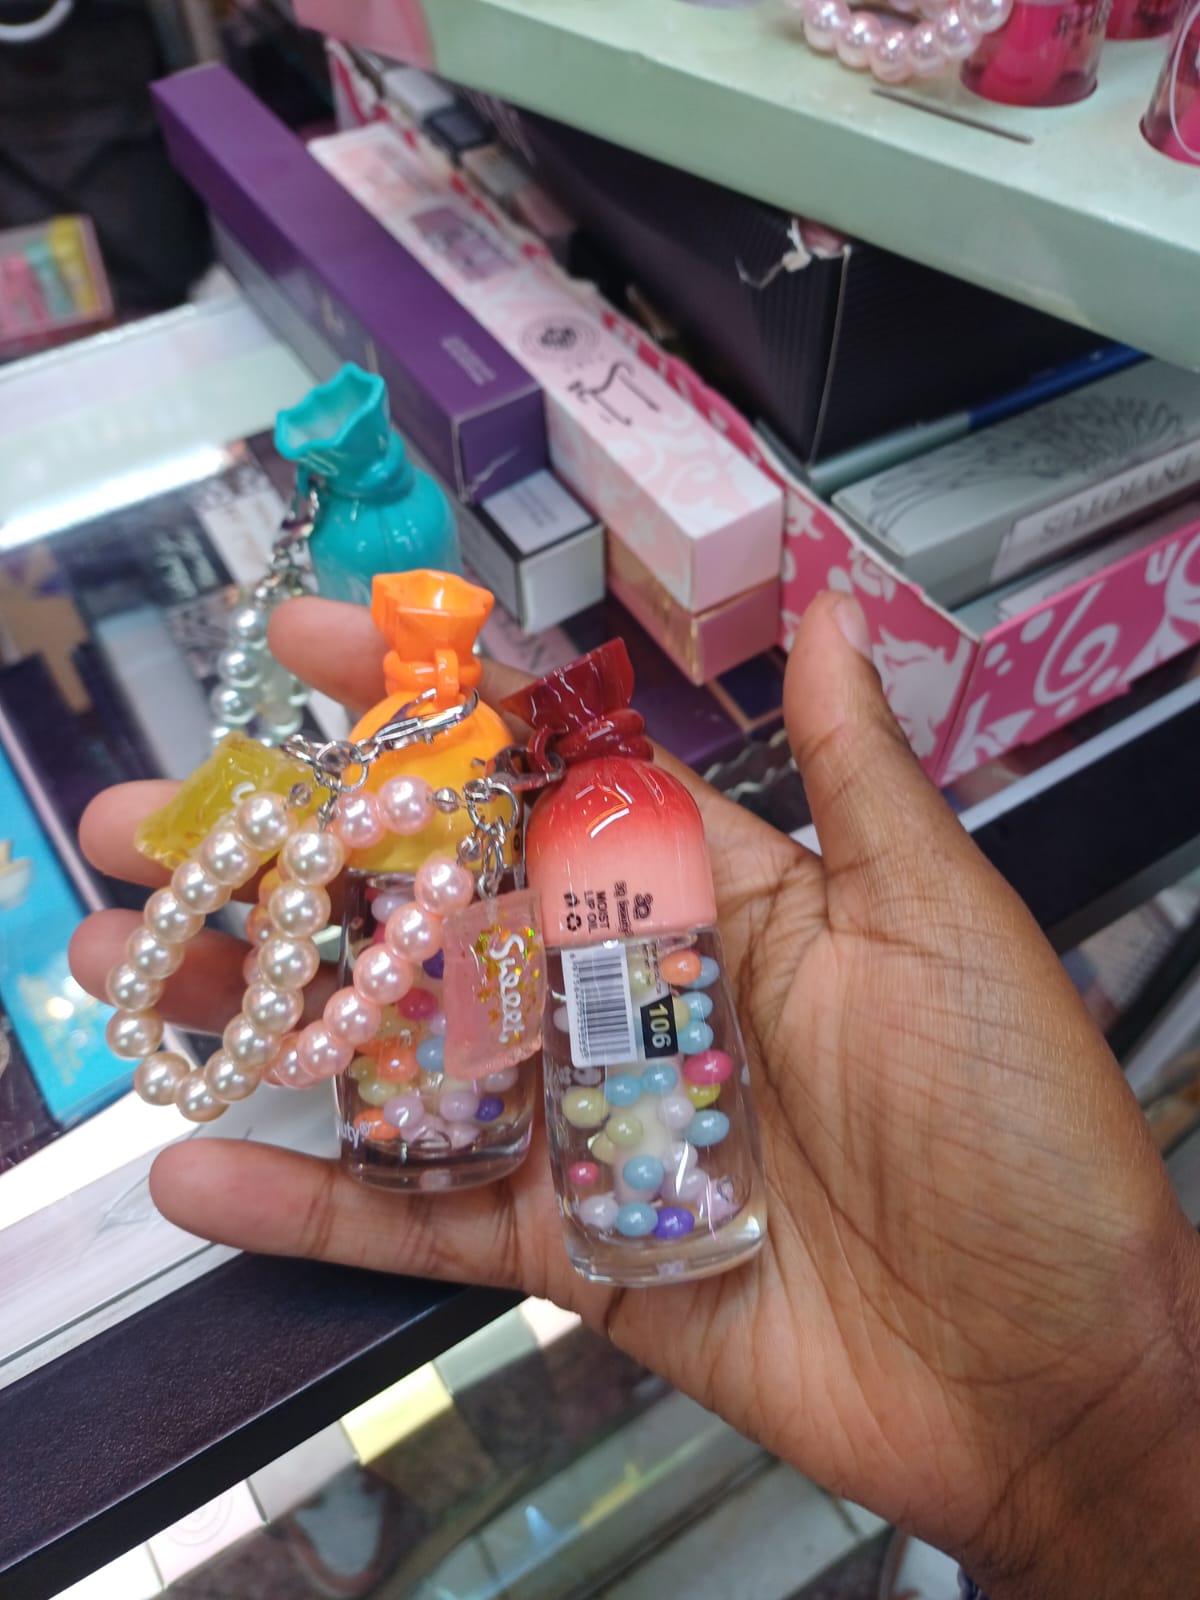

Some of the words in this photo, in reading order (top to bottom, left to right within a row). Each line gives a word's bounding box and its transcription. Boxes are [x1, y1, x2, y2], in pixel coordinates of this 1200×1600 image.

[596, 891, 610, 930] MOIST
[489, 934, 526, 1043] Sweet
[648, 1002, 672, 1049] 106
